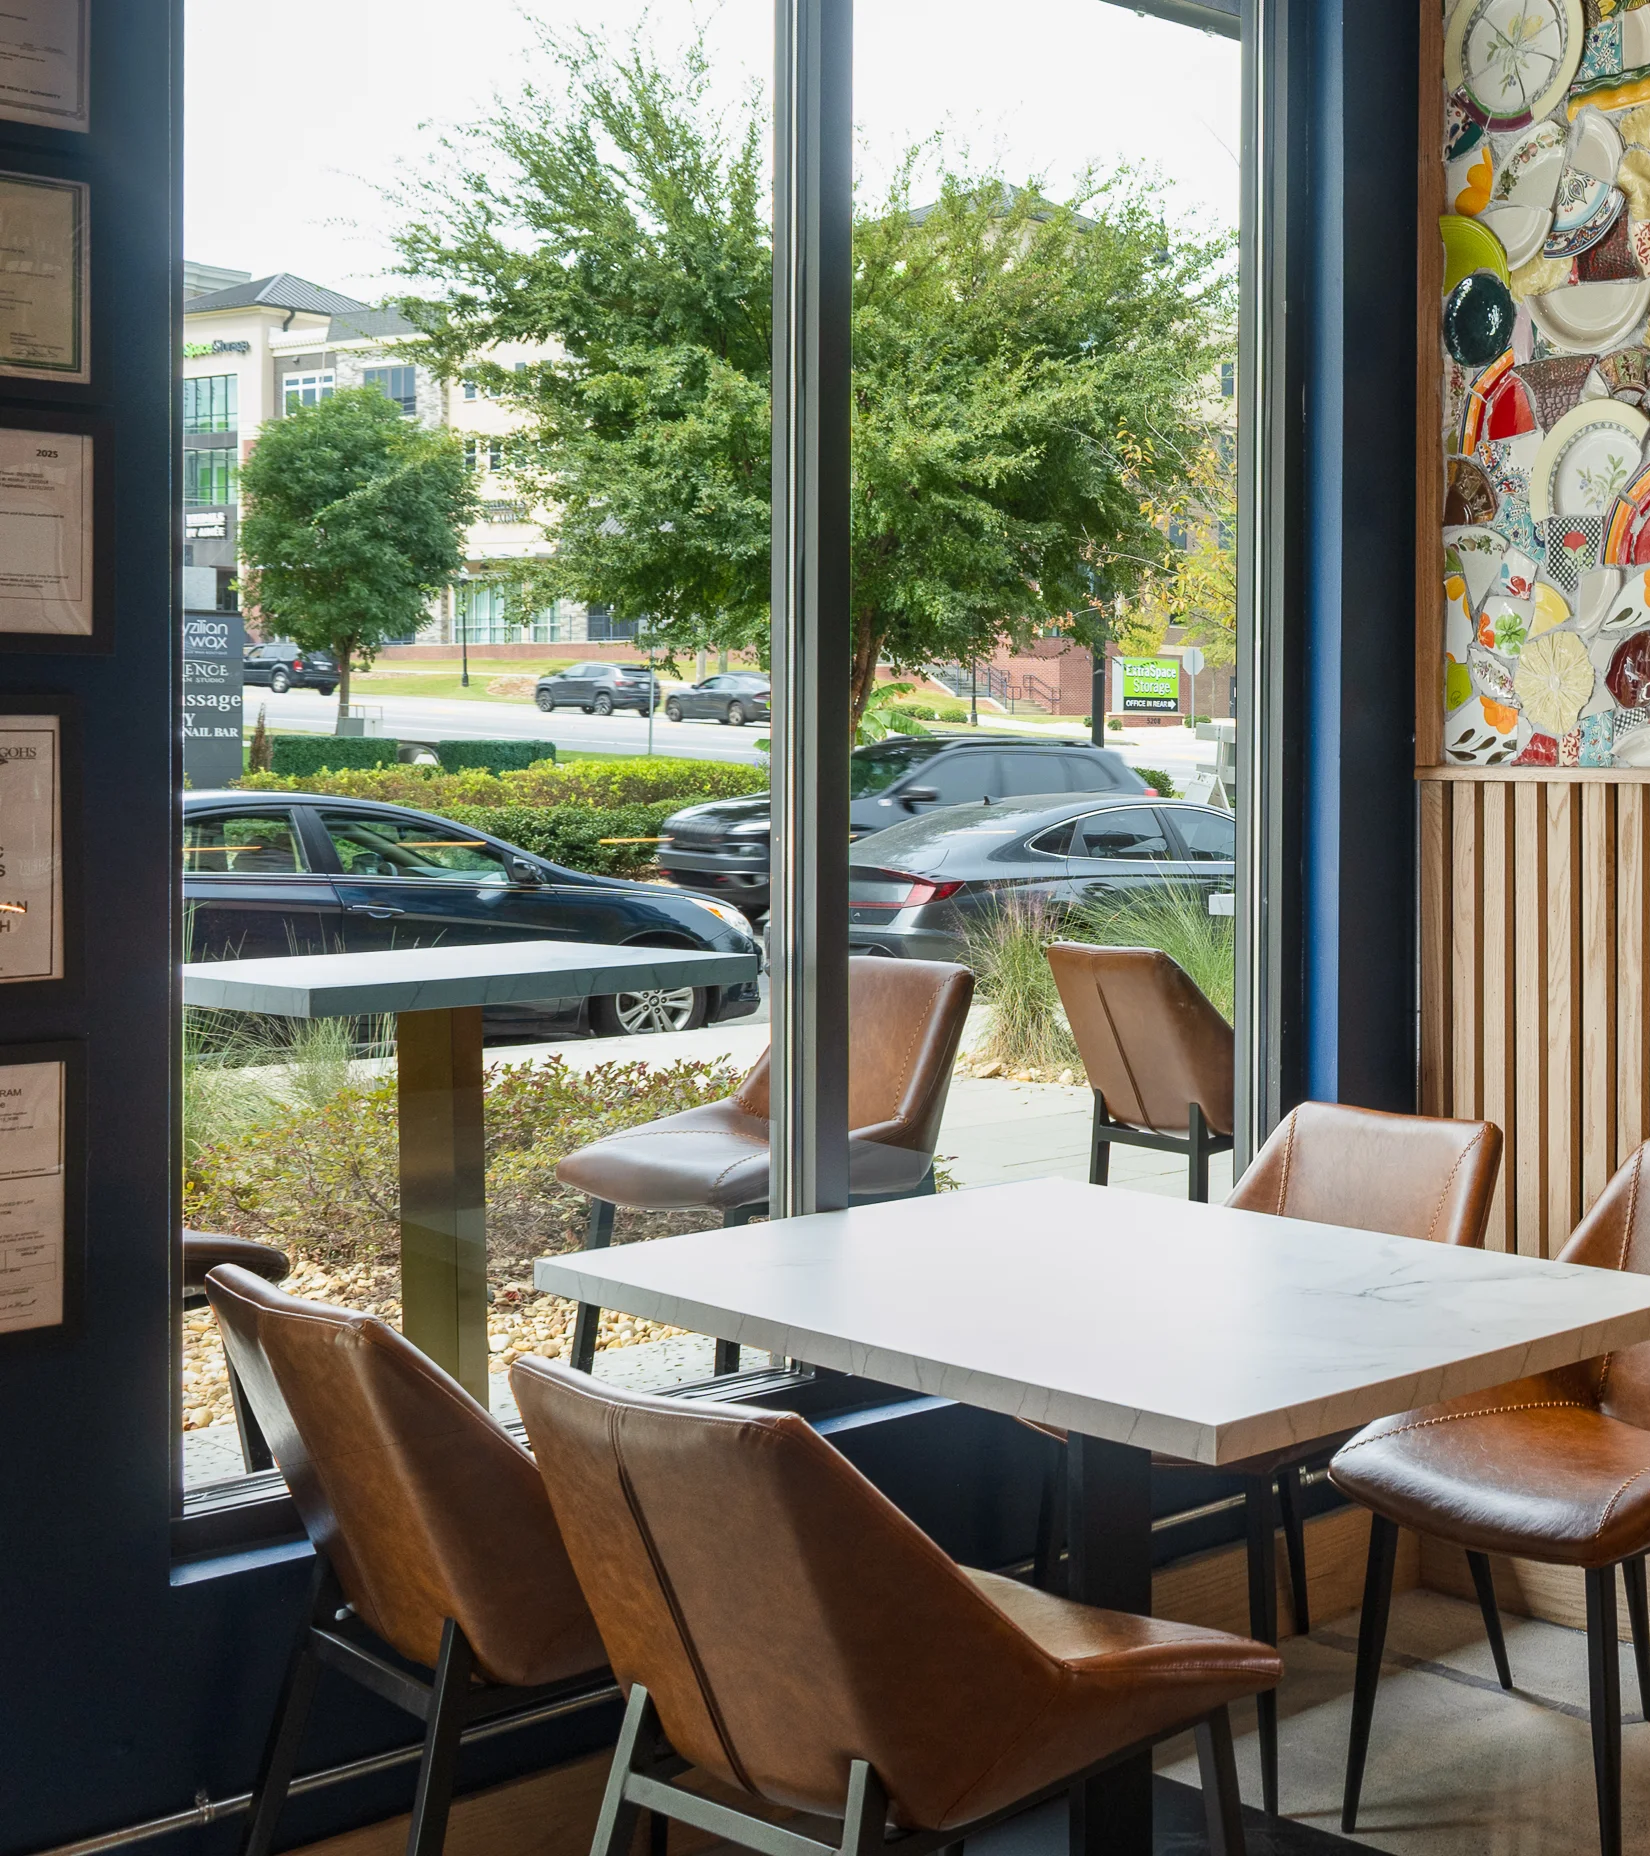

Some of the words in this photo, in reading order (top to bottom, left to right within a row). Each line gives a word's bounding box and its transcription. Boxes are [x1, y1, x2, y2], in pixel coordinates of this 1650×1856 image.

[36, 449, 59, 458] 2025
[189, 636, 228, 650] wax
[1133, 679, 1170, 695] Storage
[1126, 700, 1146, 708] OFFICE
[1147, 700, 1153, 708] IN
[1153, 701, 1168, 709] REAR
[214, 728, 239, 737] BAR
